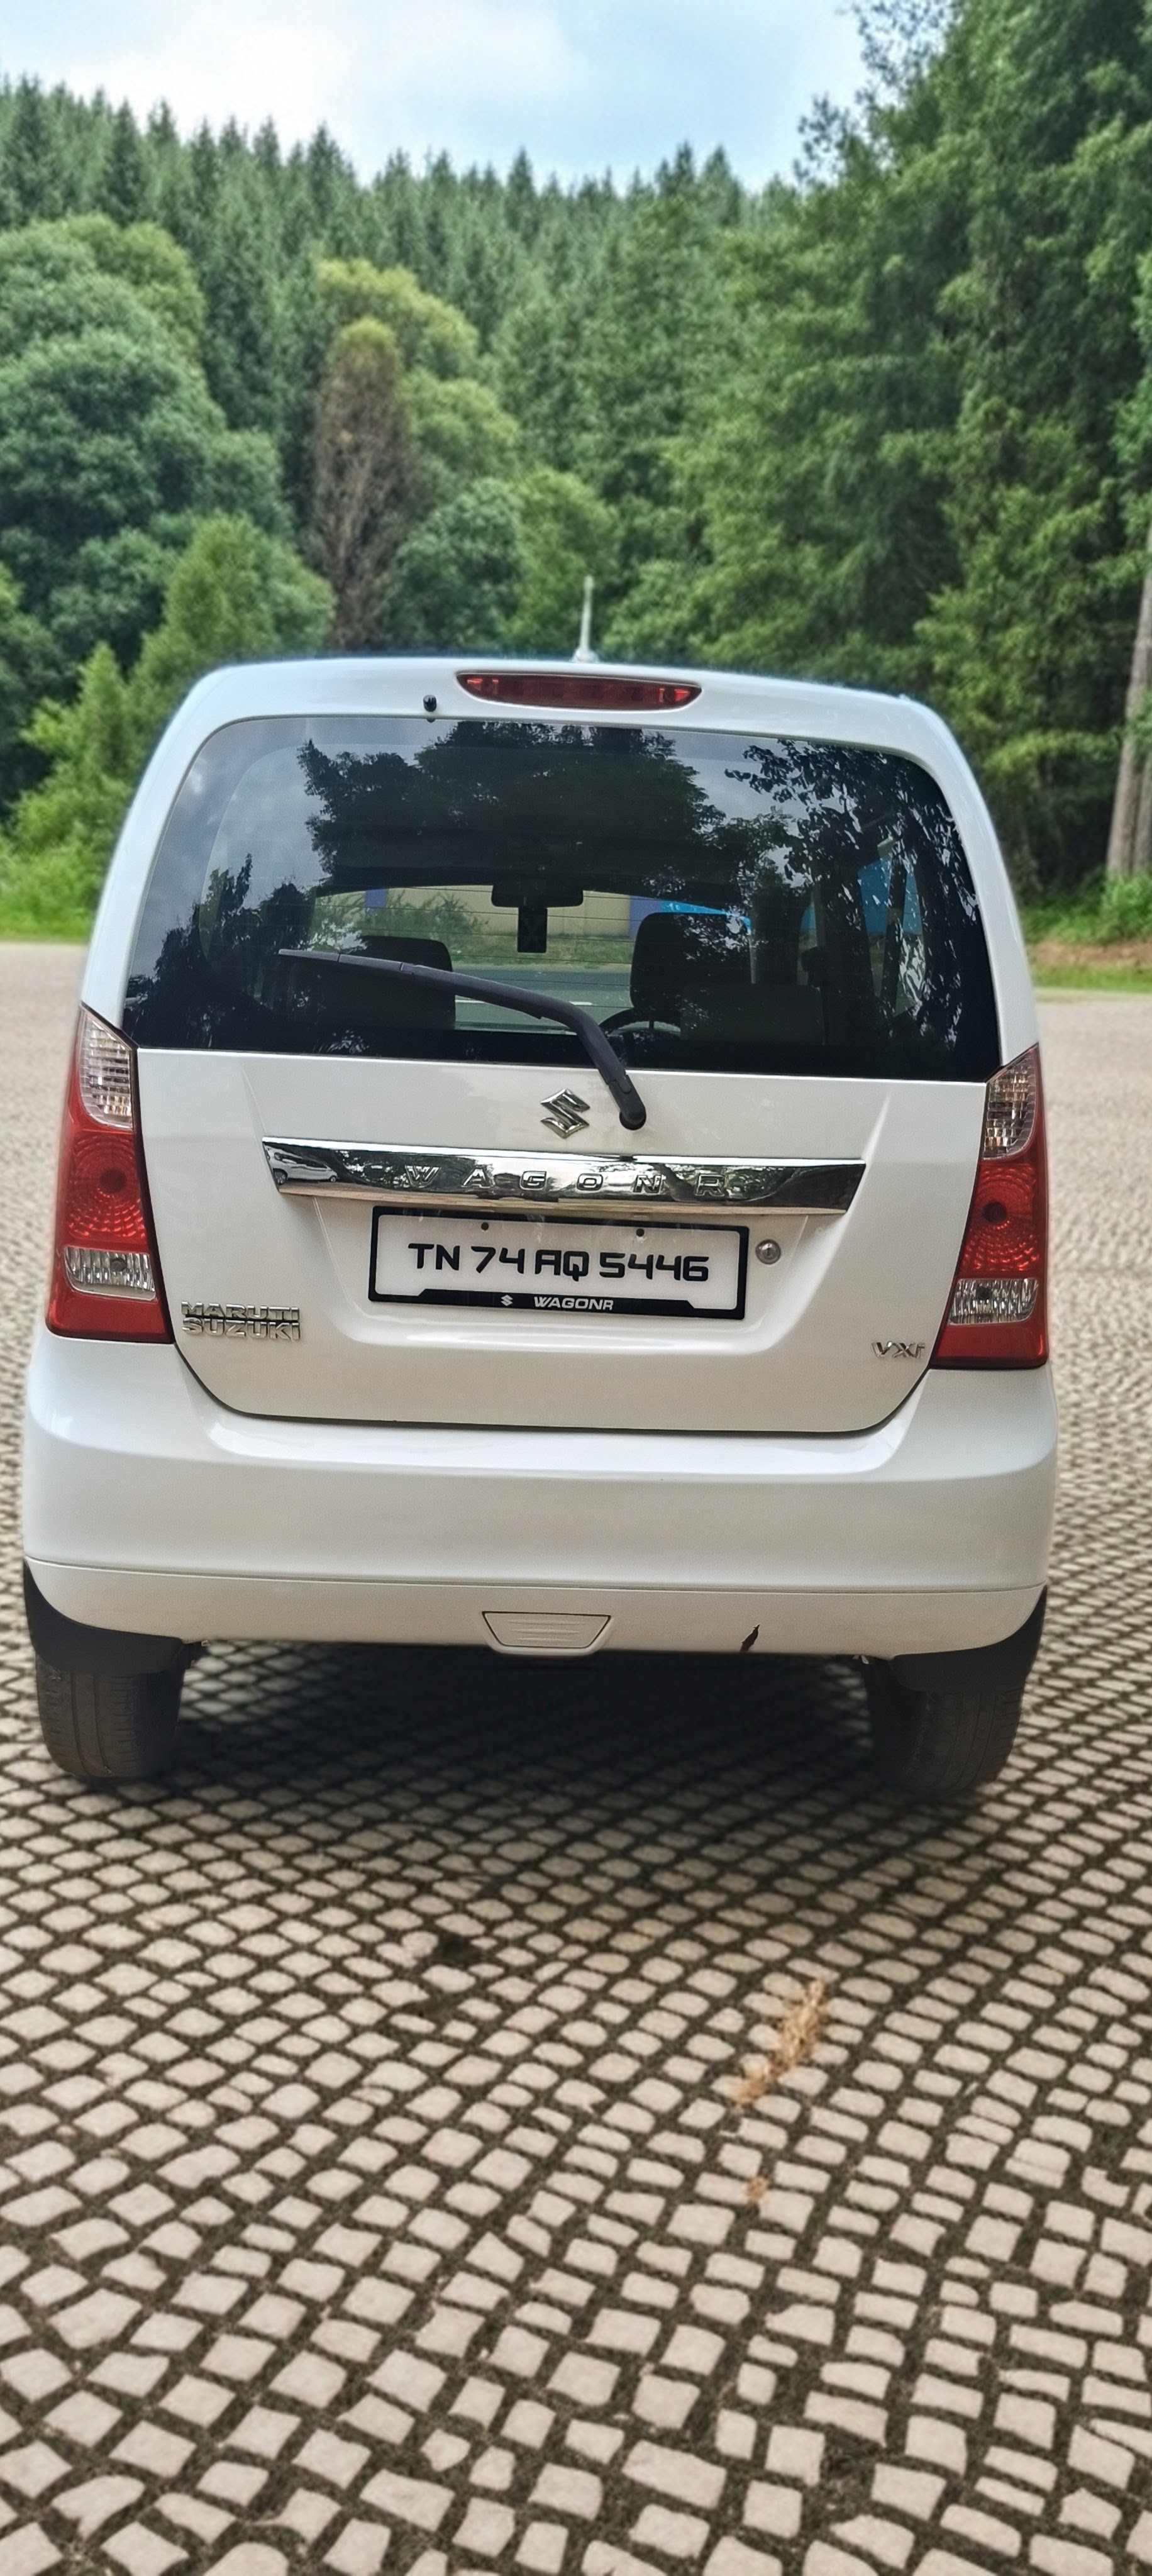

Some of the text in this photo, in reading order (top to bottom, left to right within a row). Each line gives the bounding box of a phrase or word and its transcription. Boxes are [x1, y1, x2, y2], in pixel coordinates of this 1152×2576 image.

[407, 1243, 710, 1282] TN 74 AQ 5446
[181, 1301, 299, 1321] MARUTI
[533, 1296, 614, 1311] WAGONR
[182, 1317, 301, 1340] SUZUKI
